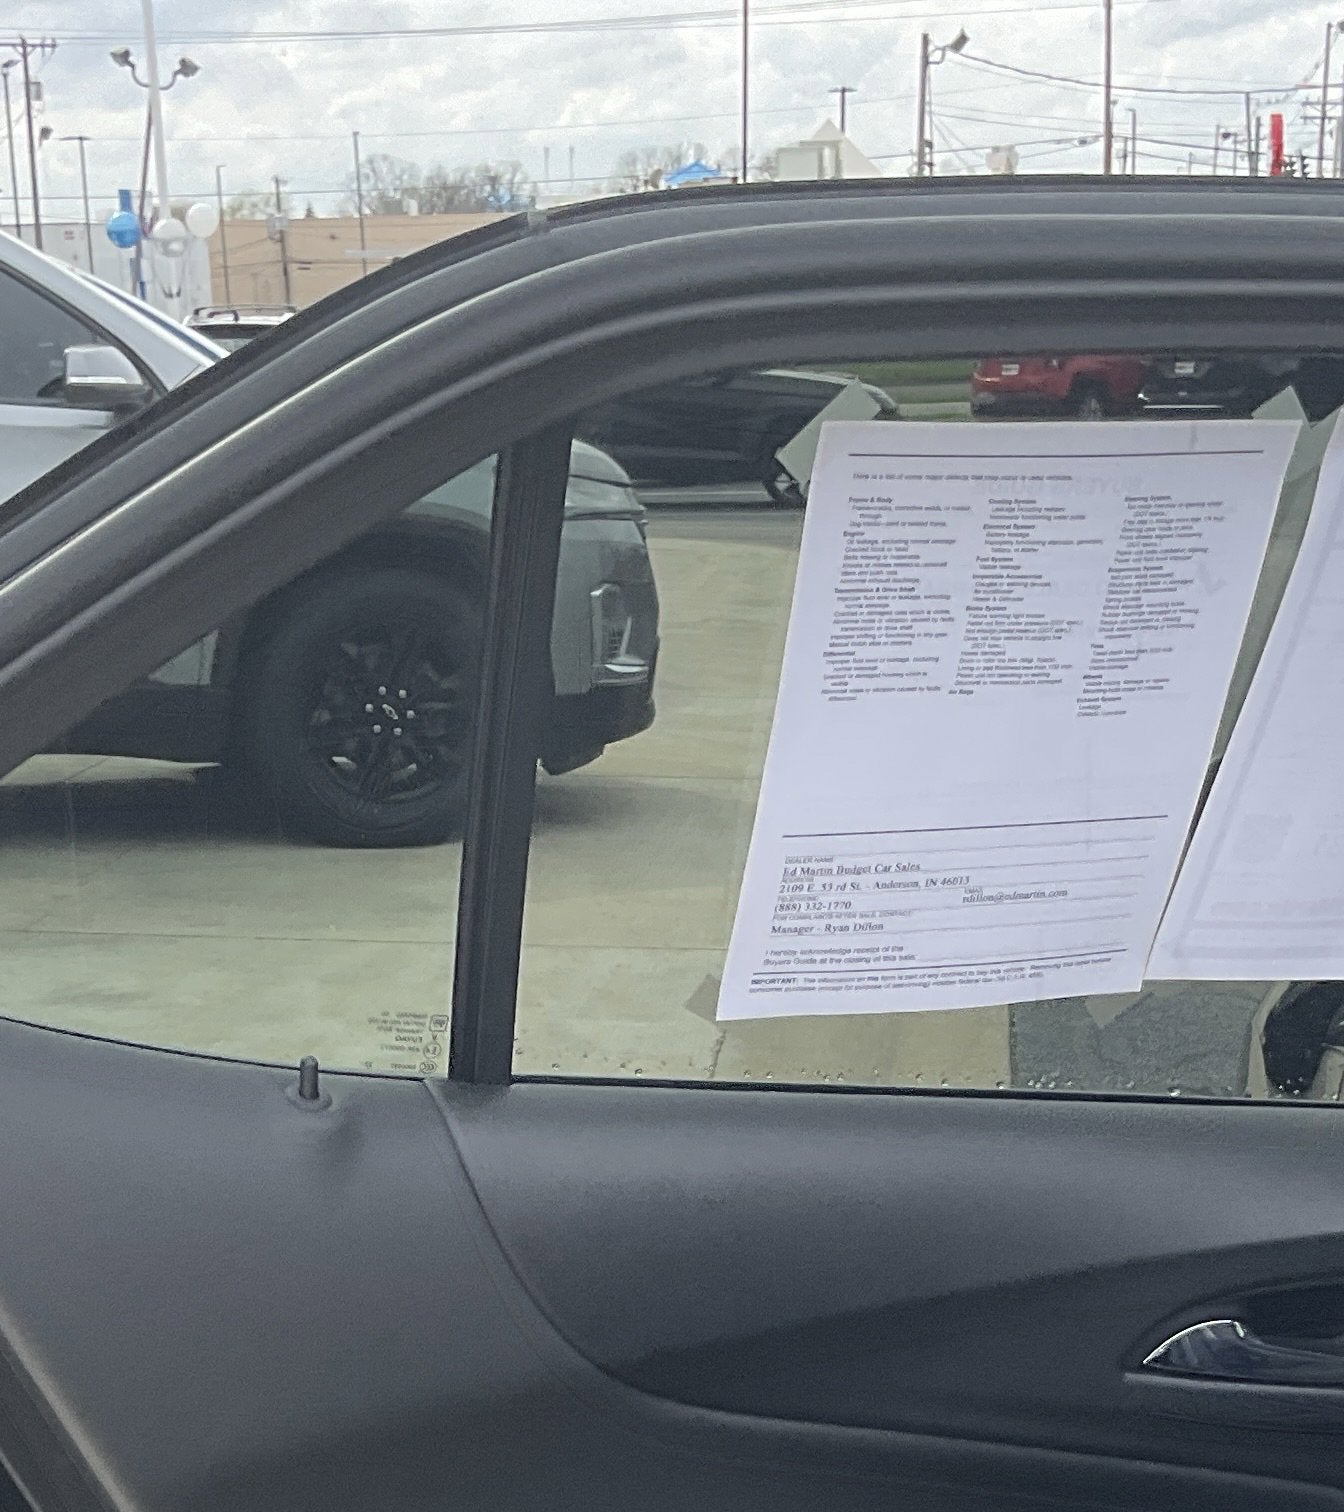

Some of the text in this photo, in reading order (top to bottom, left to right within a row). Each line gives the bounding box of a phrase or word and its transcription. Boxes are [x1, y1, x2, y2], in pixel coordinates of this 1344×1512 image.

[875, 863, 892, 873] Car
[895, 862, 921, 872] Sales
[778, 884, 804, 894] 2109
[924, 878, 937, 887] IN
[774, 902, 802, 913] (888)
[770, 925, 814, 935] Manager
[824, 923, 850, 935] Ryan
